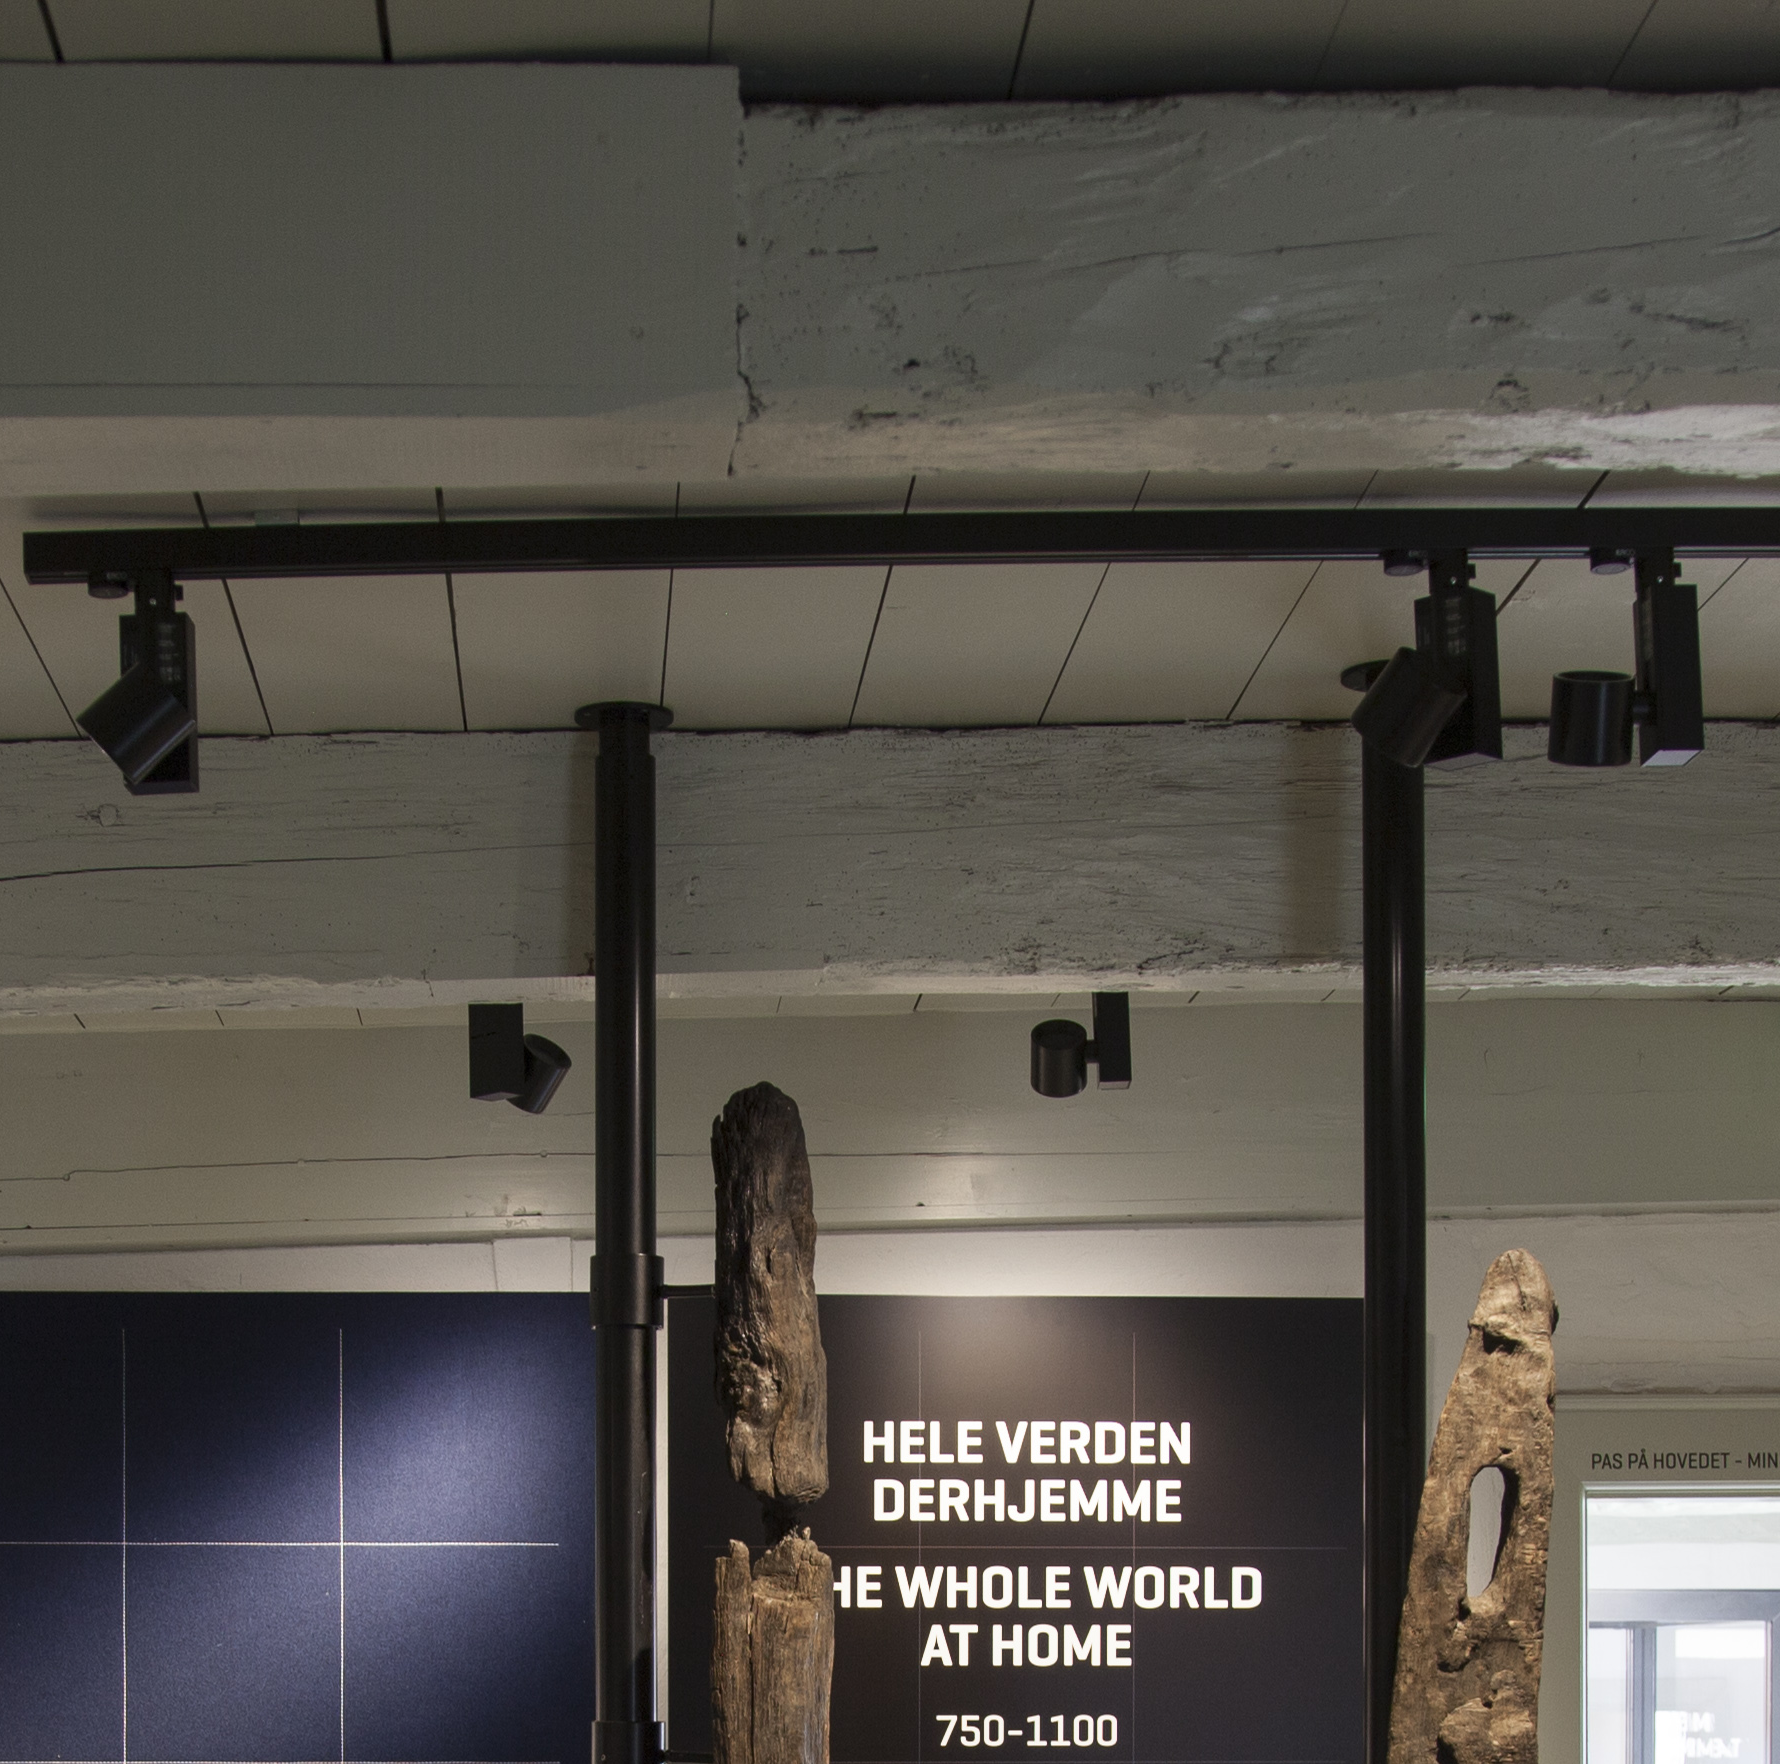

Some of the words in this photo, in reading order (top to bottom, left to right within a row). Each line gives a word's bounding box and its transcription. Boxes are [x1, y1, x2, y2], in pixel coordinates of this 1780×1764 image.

[863, 1420, 983, 1464] HELE
[995, 1421, 1191, 1465] VERDEN
[1591, 1452, 1623, 1470] PAS
[1627, 1448, 1649, 1469] PÅ
[1653, 1452, 1730, 1470] HOVEDET
[873, 1479, 1182, 1523] DERHJEMME
[832, 1565, 882, 1608] HE
[894, 1565, 1071, 1608] WHOLE
[1083, 1566, 1262, 1609] WORLD
[921, 1624, 979, 1667] AT
[992, 1624, 1132, 1667] HOME
[935, 1714, 1118, 1747] 750-1100
